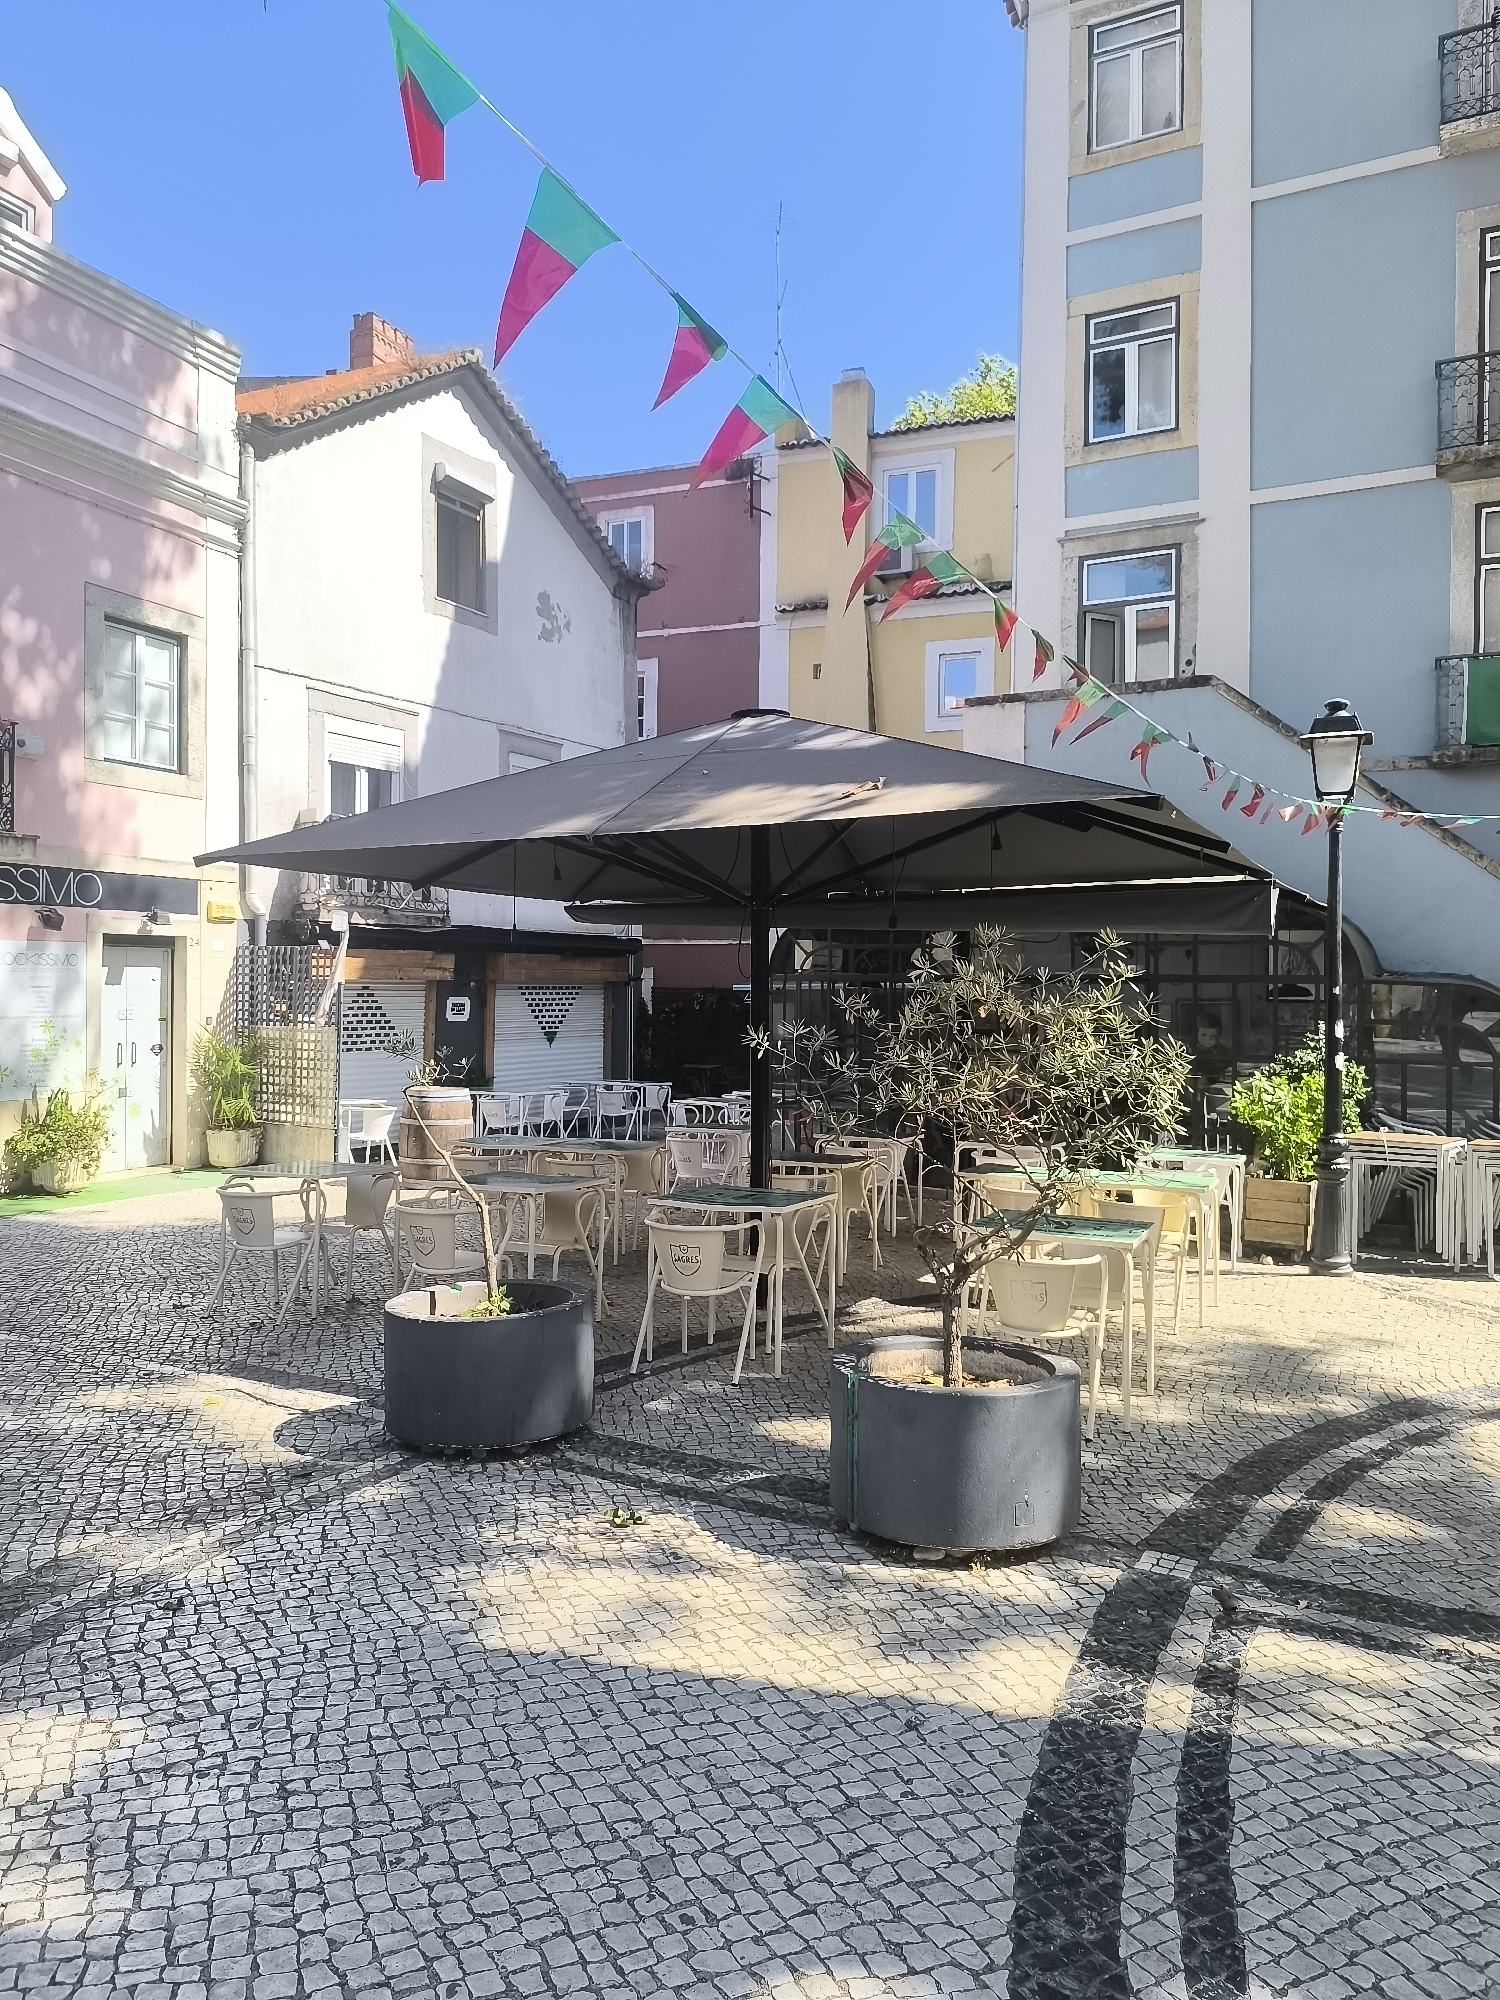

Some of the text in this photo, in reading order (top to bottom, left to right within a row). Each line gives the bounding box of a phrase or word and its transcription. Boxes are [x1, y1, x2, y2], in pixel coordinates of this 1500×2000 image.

[0, 865, 104, 906] SSIMO
[189, 937, 200, 947] 24
[673, 1253, 700, 1264] SAGRES
[1014, 1290, 1045, 1302] SGRES
